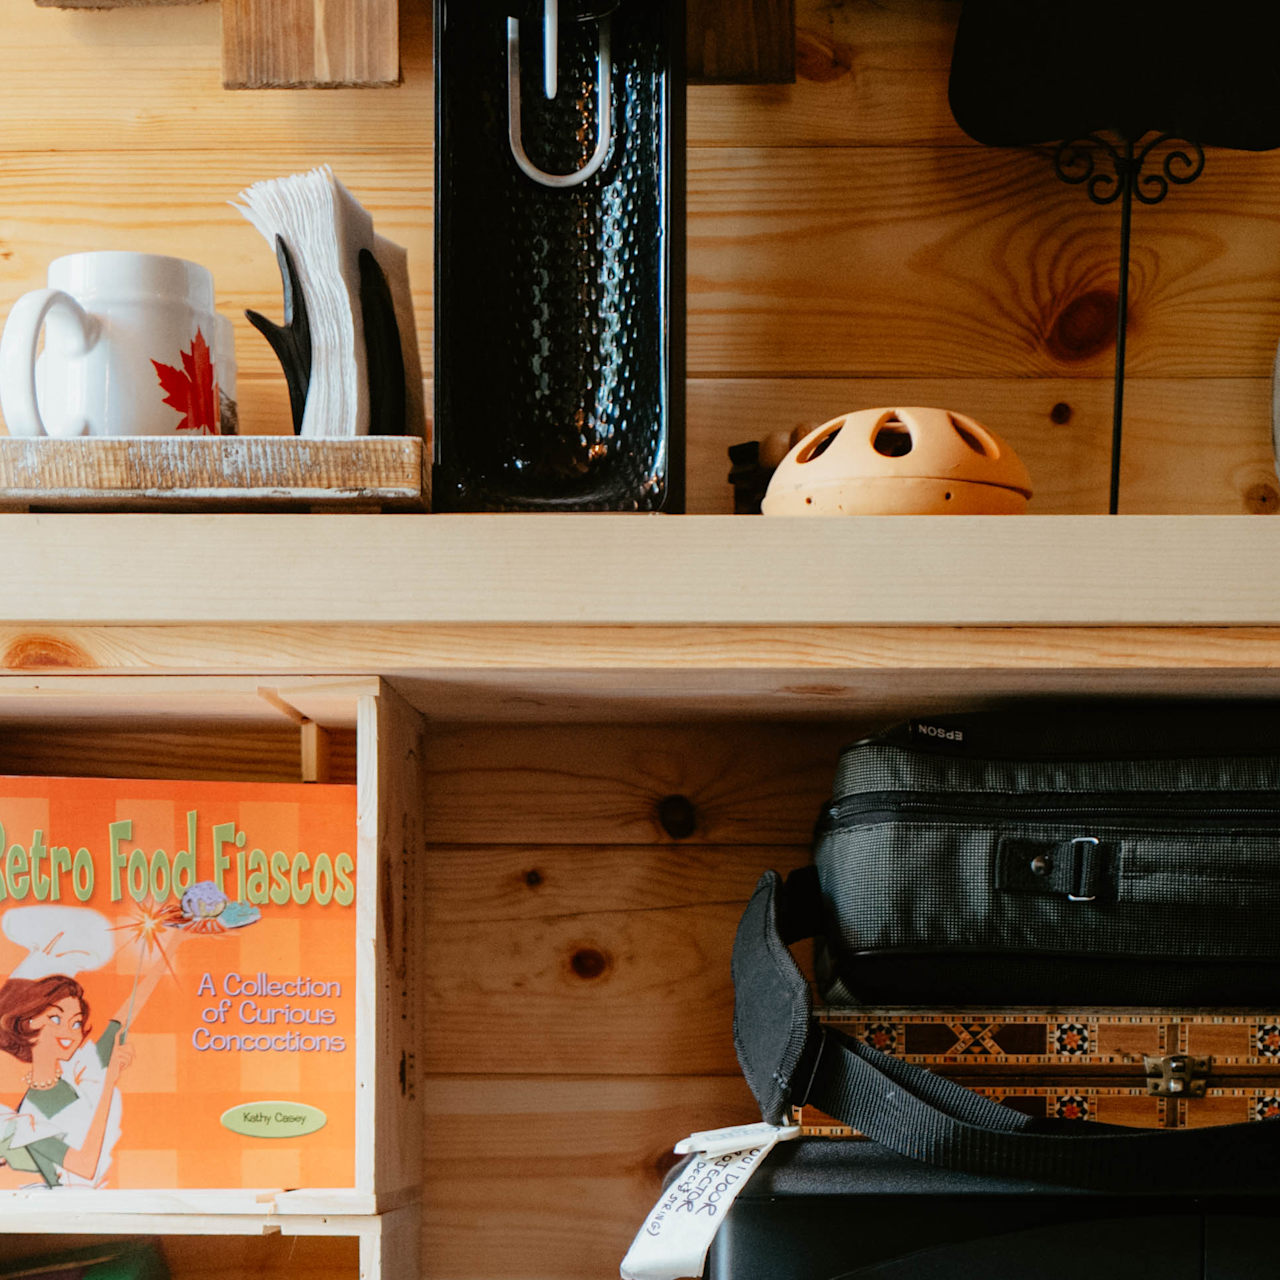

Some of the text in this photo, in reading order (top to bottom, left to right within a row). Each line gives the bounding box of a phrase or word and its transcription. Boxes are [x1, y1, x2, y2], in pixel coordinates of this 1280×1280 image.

[919, 724, 963, 741] EPSON
[108, 810, 197, 903] Food
[212, 821, 354, 907] Fiascos
[197, 972, 342, 998] A Collection
[202, 999, 337, 1025] of Curious
[192, 1027, 347, 1052] Concoctions
[243, 1112, 306, 1126] Kathy Casey
